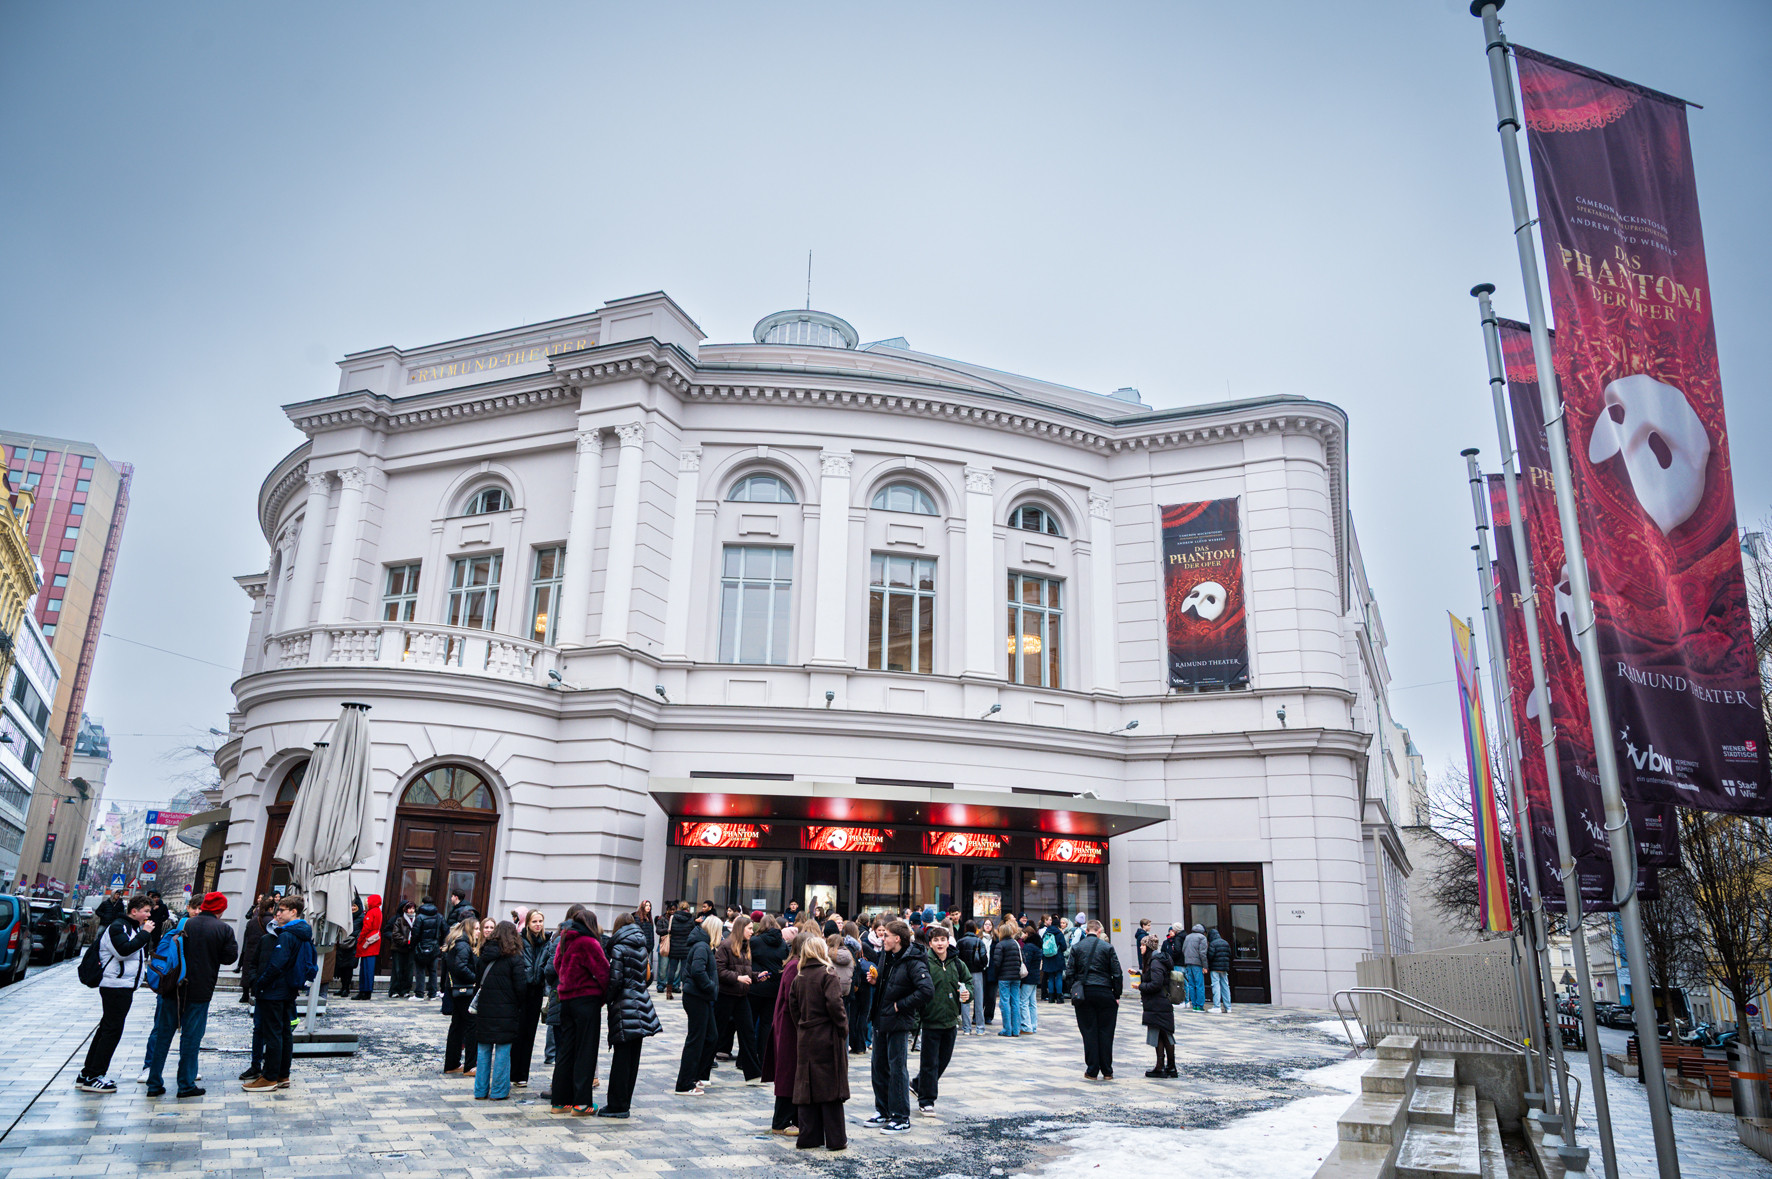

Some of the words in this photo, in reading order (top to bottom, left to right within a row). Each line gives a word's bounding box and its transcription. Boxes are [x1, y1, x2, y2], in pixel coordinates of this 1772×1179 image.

[1576, 195, 1615, 214] CAMERON
[1570, 216, 1610, 232] ANDREW
[1614, 245, 1642, 269] DAS
[1556, 242, 1702, 314] PHANTOM
[1591, 284, 1627, 308] DER
[1630, 298, 1676, 322] OPER
[418, 339, 587, 382] RAIMUND-THEATER
[1169, 548, 1236, 565] PHANTOM
[1200, 560, 1222, 568] OPER
[1175, 660, 1207, 669] RAIMUND
[1208, 658, 1241, 666] THEATER
[1616, 661, 1687, 692] RAIMUND
[1688, 679, 1758, 710] THEATER
[1630, 744, 1674, 776] vbw
[849, 835, 883, 843] PHANTOM
[968, 841, 1000, 849] PHANTOM
